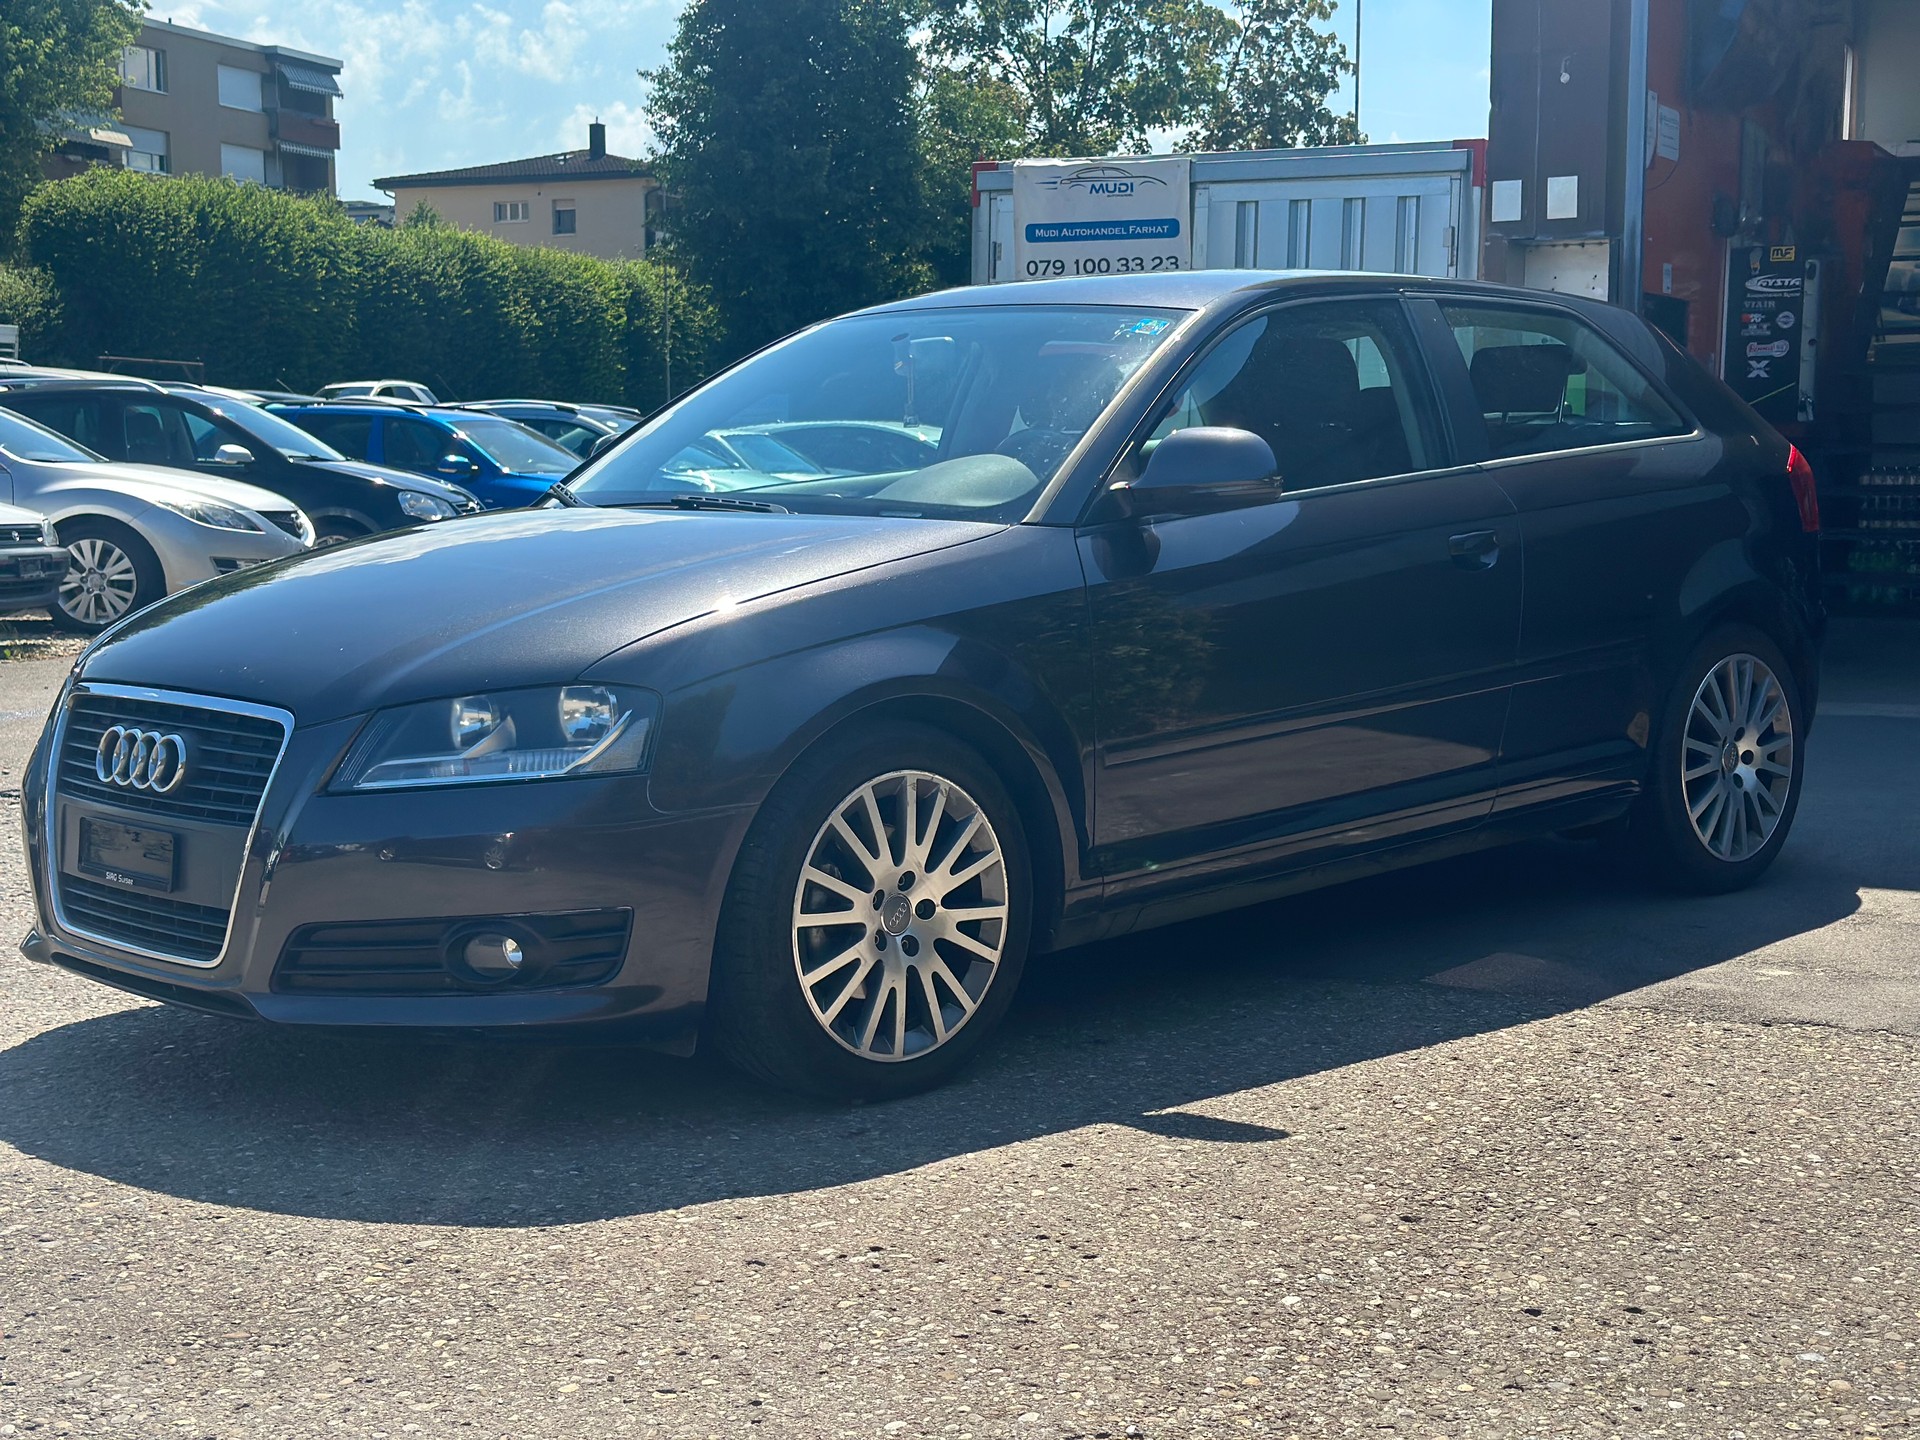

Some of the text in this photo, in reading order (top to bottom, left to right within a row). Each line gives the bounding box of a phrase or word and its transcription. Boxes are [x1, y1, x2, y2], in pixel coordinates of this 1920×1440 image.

[1089, 182, 1134, 194] MUDI
[1026, 255, 1180, 277] 079 100 33 23
